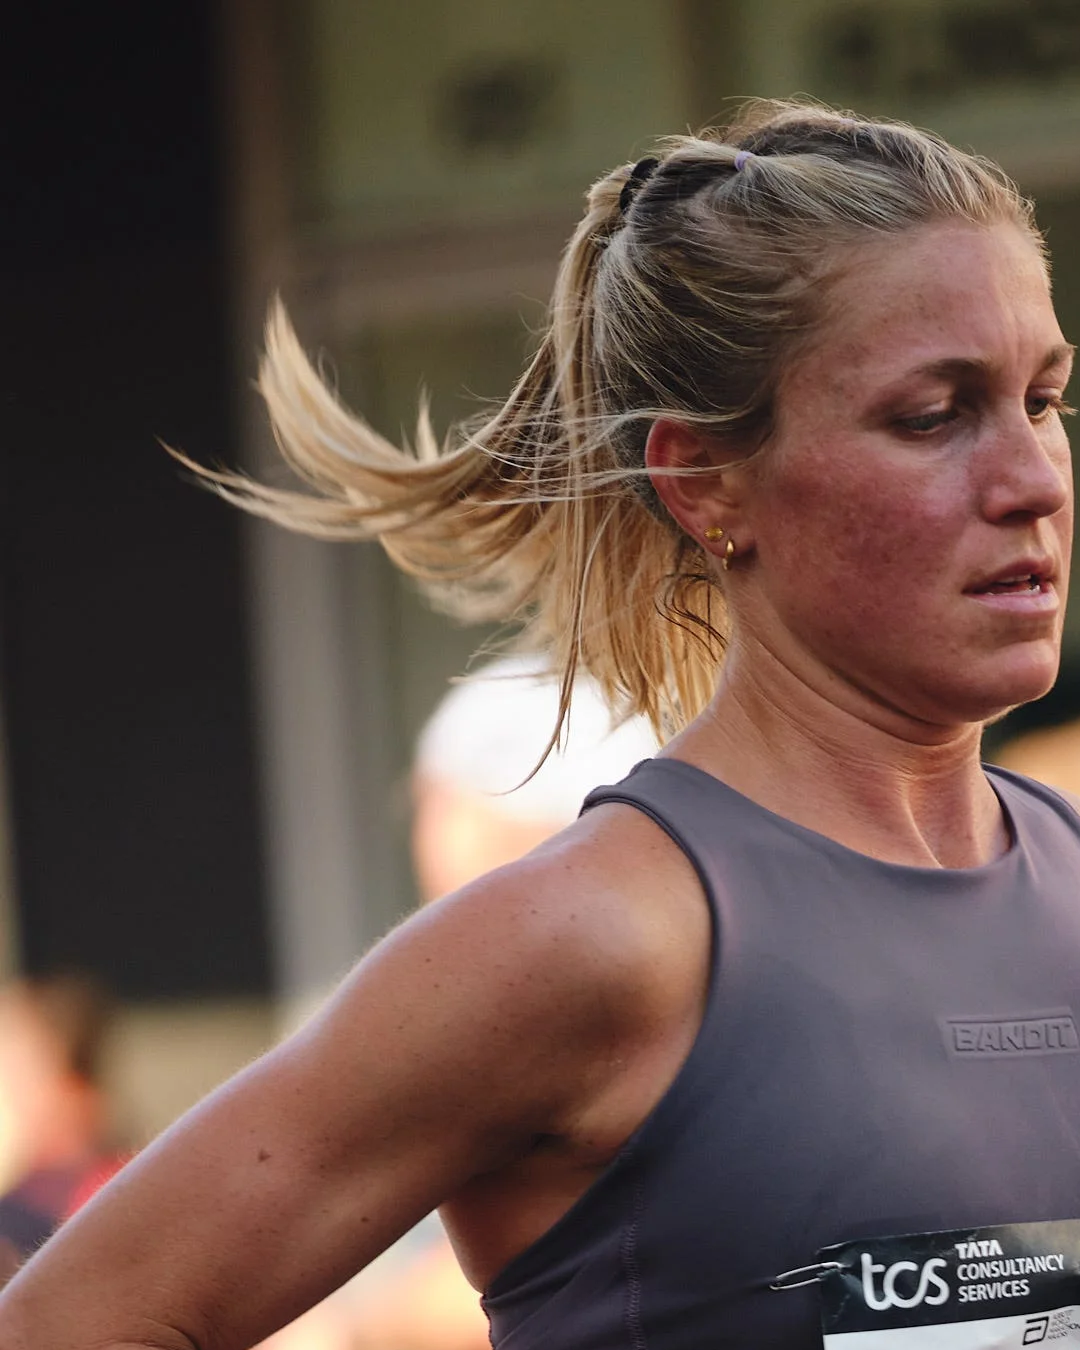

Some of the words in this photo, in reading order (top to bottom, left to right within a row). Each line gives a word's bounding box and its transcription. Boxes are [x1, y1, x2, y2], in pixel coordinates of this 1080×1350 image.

[952, 1022, 1072, 1051] BANDIT
[955, 1240, 1003, 1259] TATA
[957, 1254, 1065, 1281] CONSULTANCY
[861, 1253, 949, 1310] tcs
[958, 1279, 1031, 1303] SERVICES
